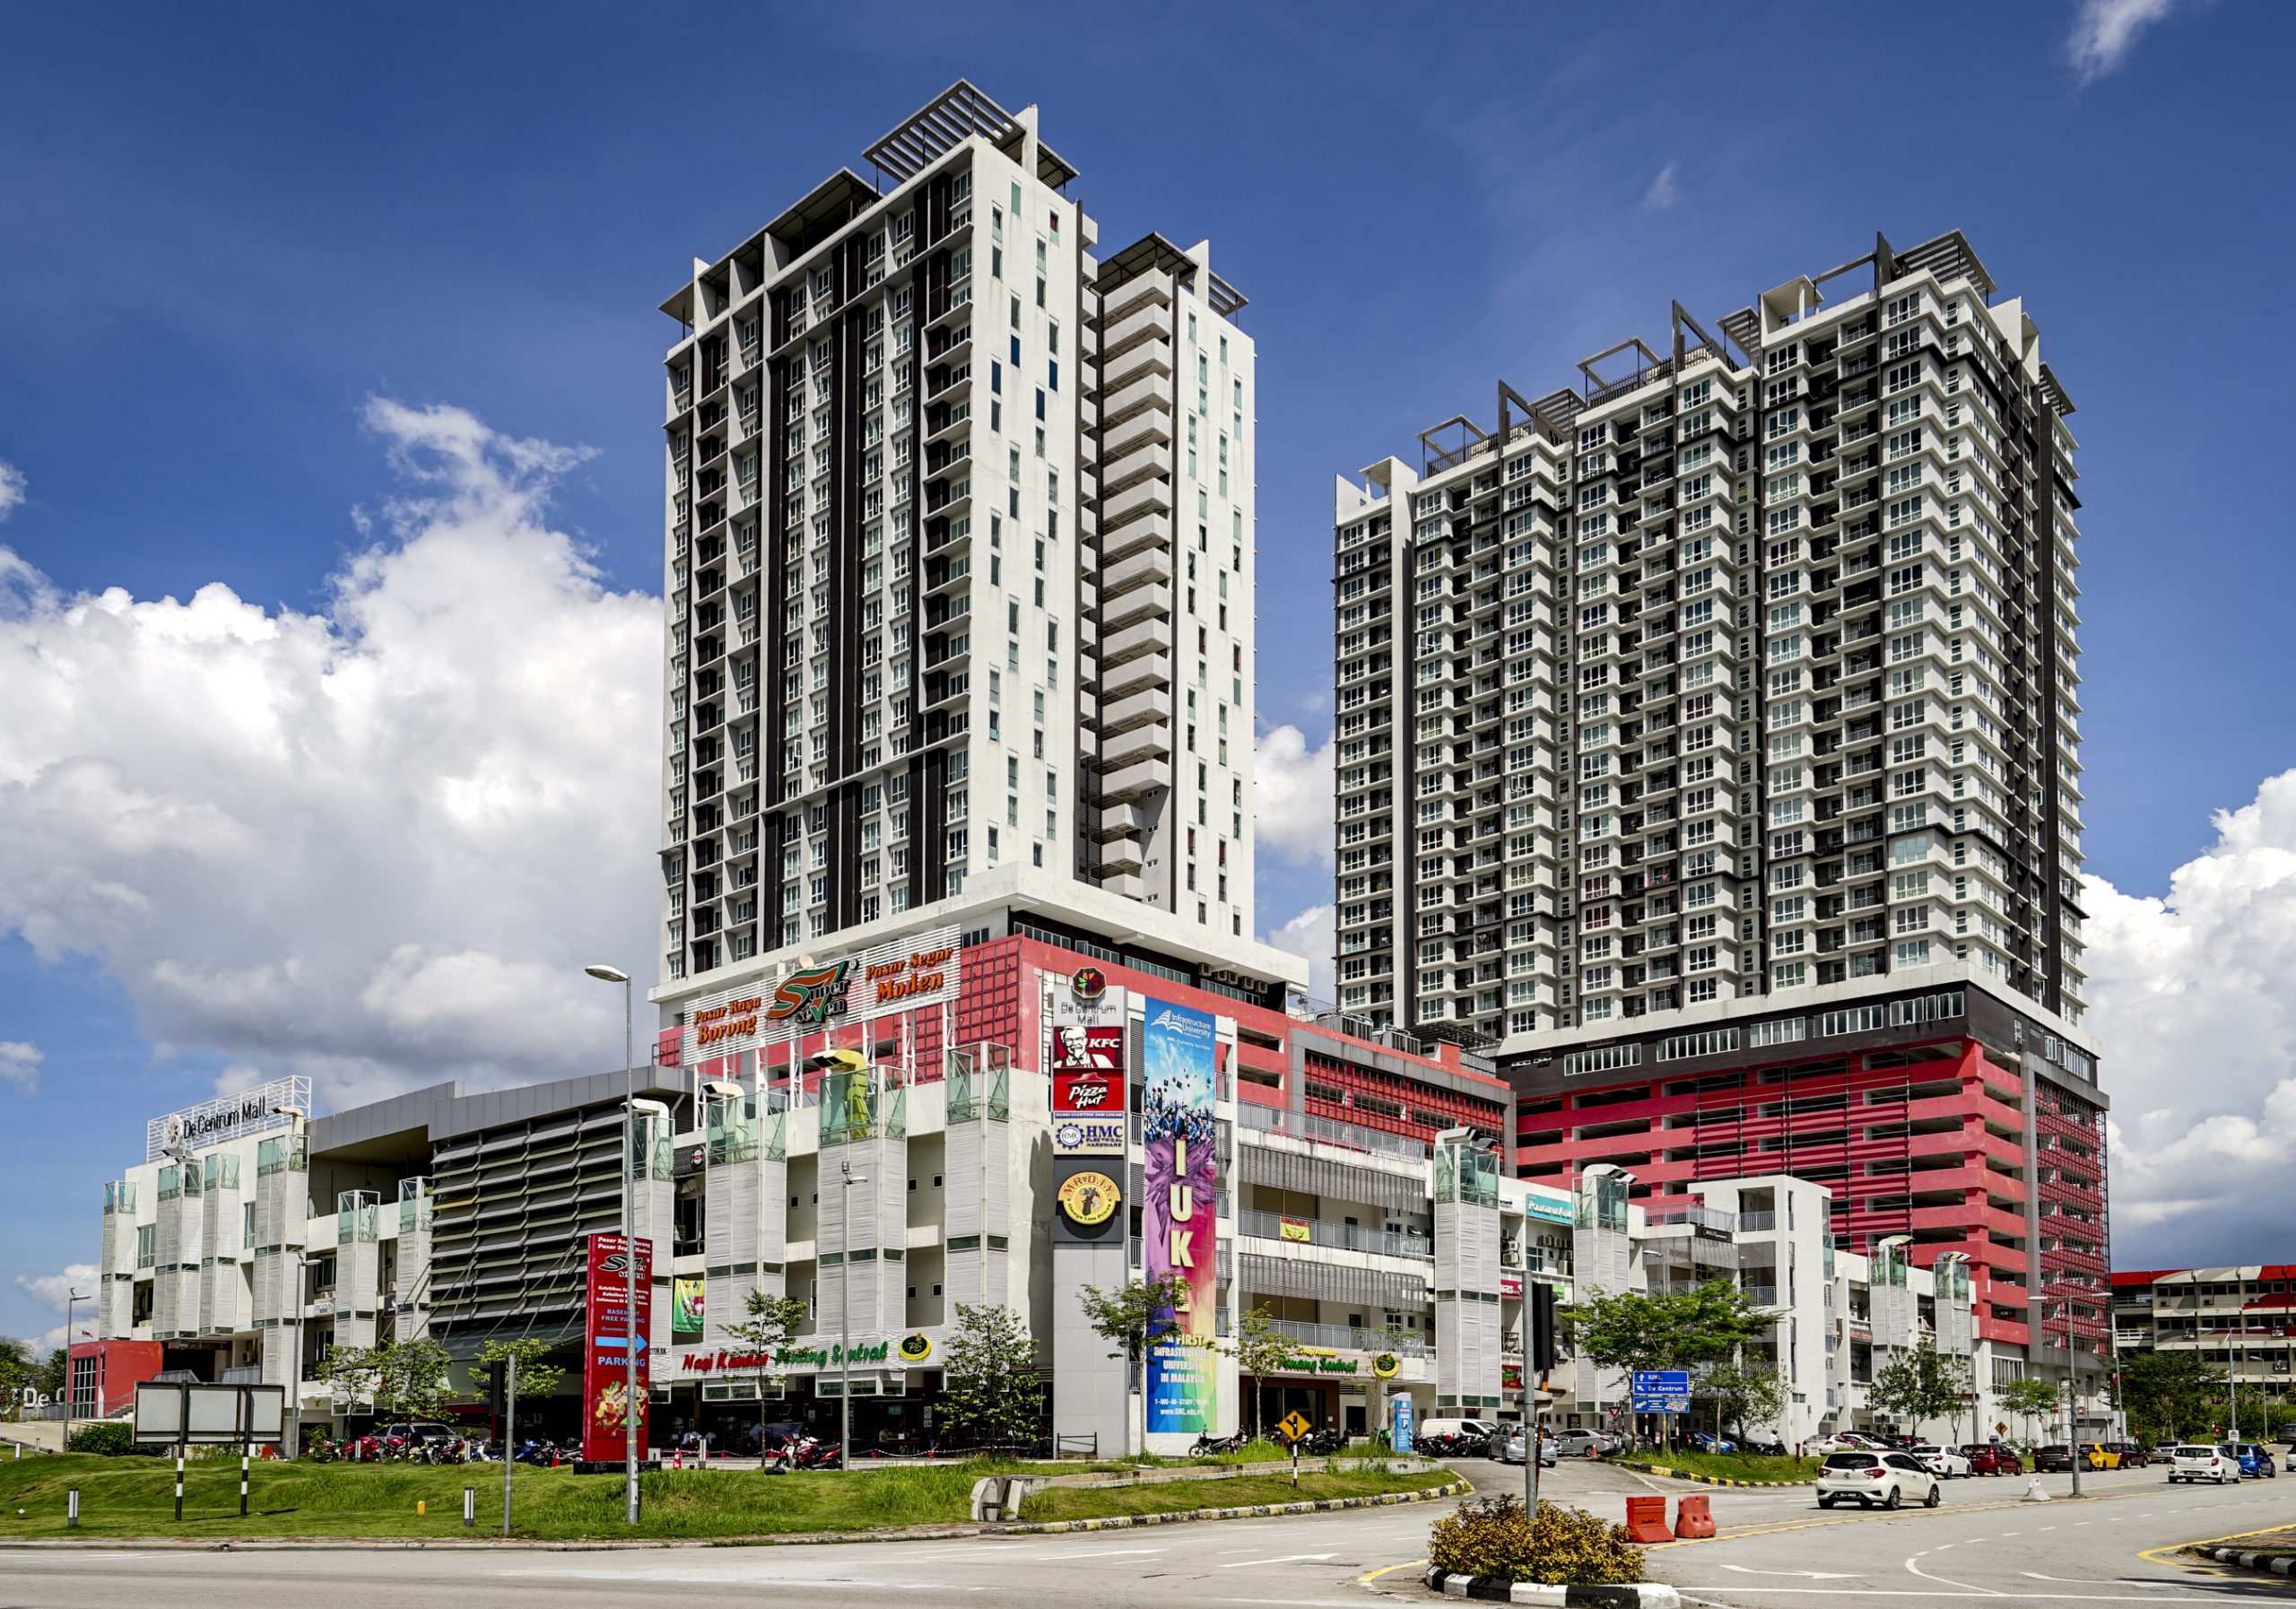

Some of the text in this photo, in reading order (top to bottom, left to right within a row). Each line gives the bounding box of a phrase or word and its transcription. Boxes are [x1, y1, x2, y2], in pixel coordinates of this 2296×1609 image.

[865, 947, 953, 980] Pasar Segar
[876, 972, 944, 1003] Moden
[693, 997, 761, 1024] Pasar Raya
[1061, 1002, 1117, 1013] De Centrum
[1077, 1014, 1100, 1025] Mall
[1171, 1013, 1211, 1030] Infrastructure
[698, 1015, 757, 1044] Borong
[1182, 1023, 1211, 1039] University
[1088, 1038, 1121, 1048] KFC
[1068, 1084, 1108, 1100] Pizza
[1075, 1094, 1106, 1109] Hut
[183, 1096, 267, 1139] De Centrum Mall
[1086, 1126, 1123, 1137] HMC
[1176, 1335, 1205, 1345] FIRST
[831, 1341, 889, 1362] Sntral
[598, 1356, 646, 1367] PARKNG
[1163, 1360, 1203, 1370] UNIVERSITY
[1161, 1373, 1205, 1383] IN MALAYSIA
[23, 1387, 50, 1408] De
